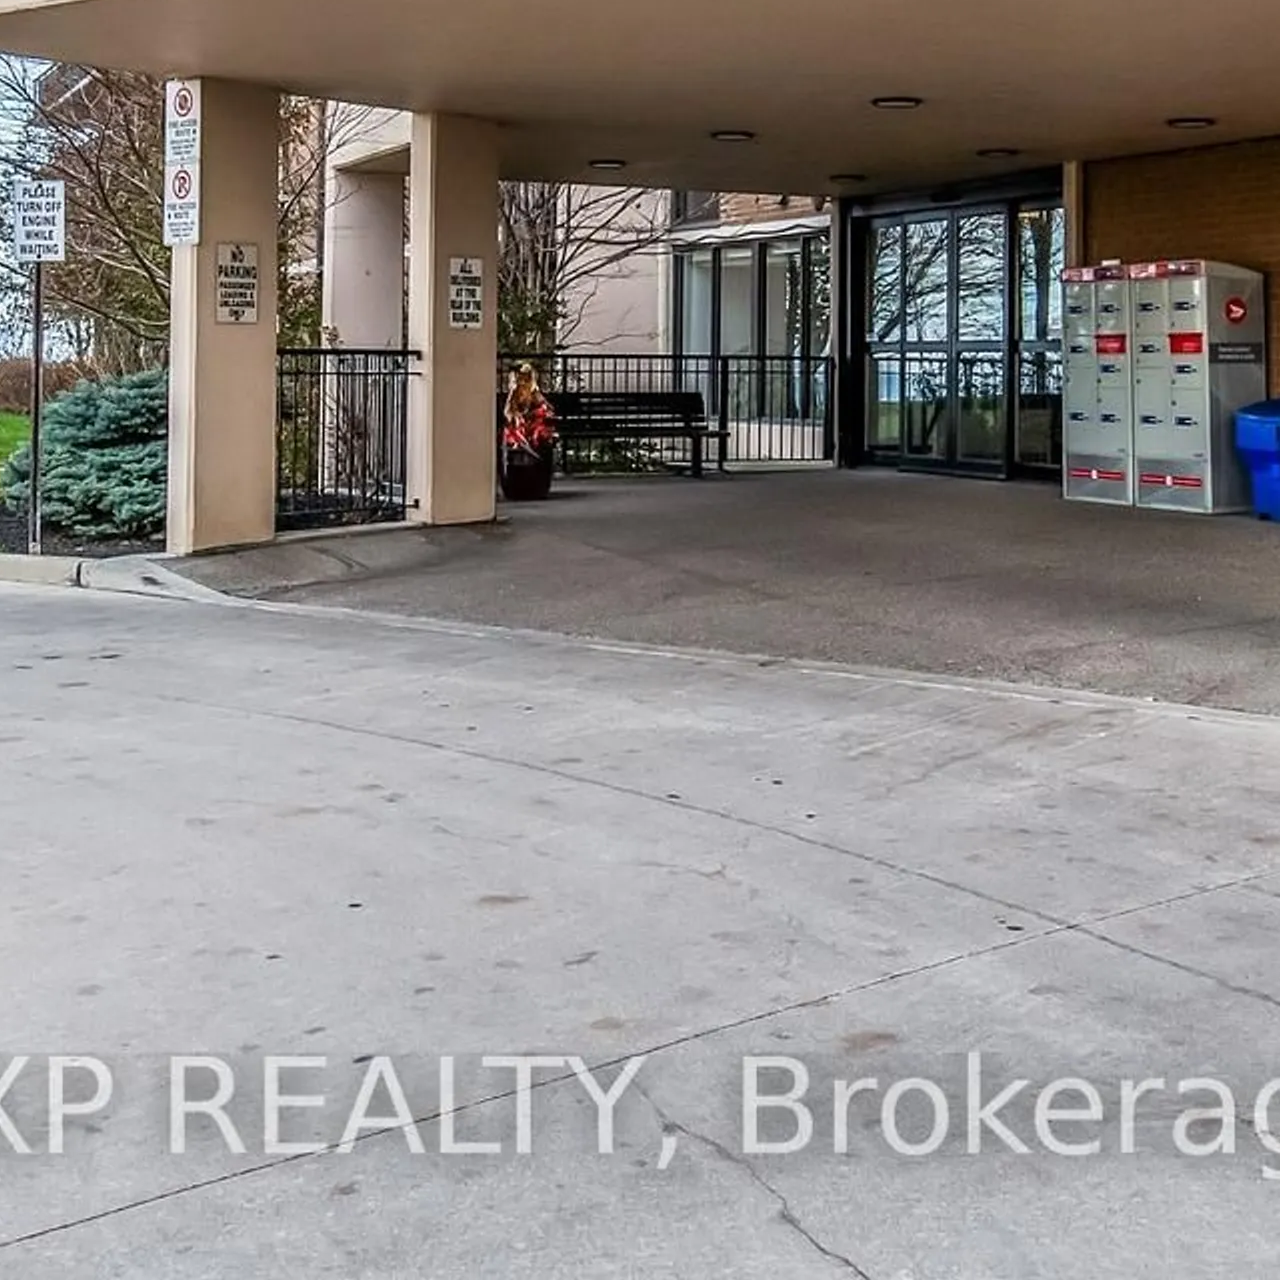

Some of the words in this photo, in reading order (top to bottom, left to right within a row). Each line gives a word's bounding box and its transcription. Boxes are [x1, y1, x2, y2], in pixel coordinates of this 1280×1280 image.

[22, 187, 55, 198] PLEASE
[16, 202, 42, 212] TURN
[44, 202, 61, 212] OFF
[22, 216, 55, 227] ENGINE
[24, 230, 53, 241] WHILE
[20, 244, 59, 255] WAITING
[231, 249, 245, 263] NO
[218, 264, 257, 279] PARKING
